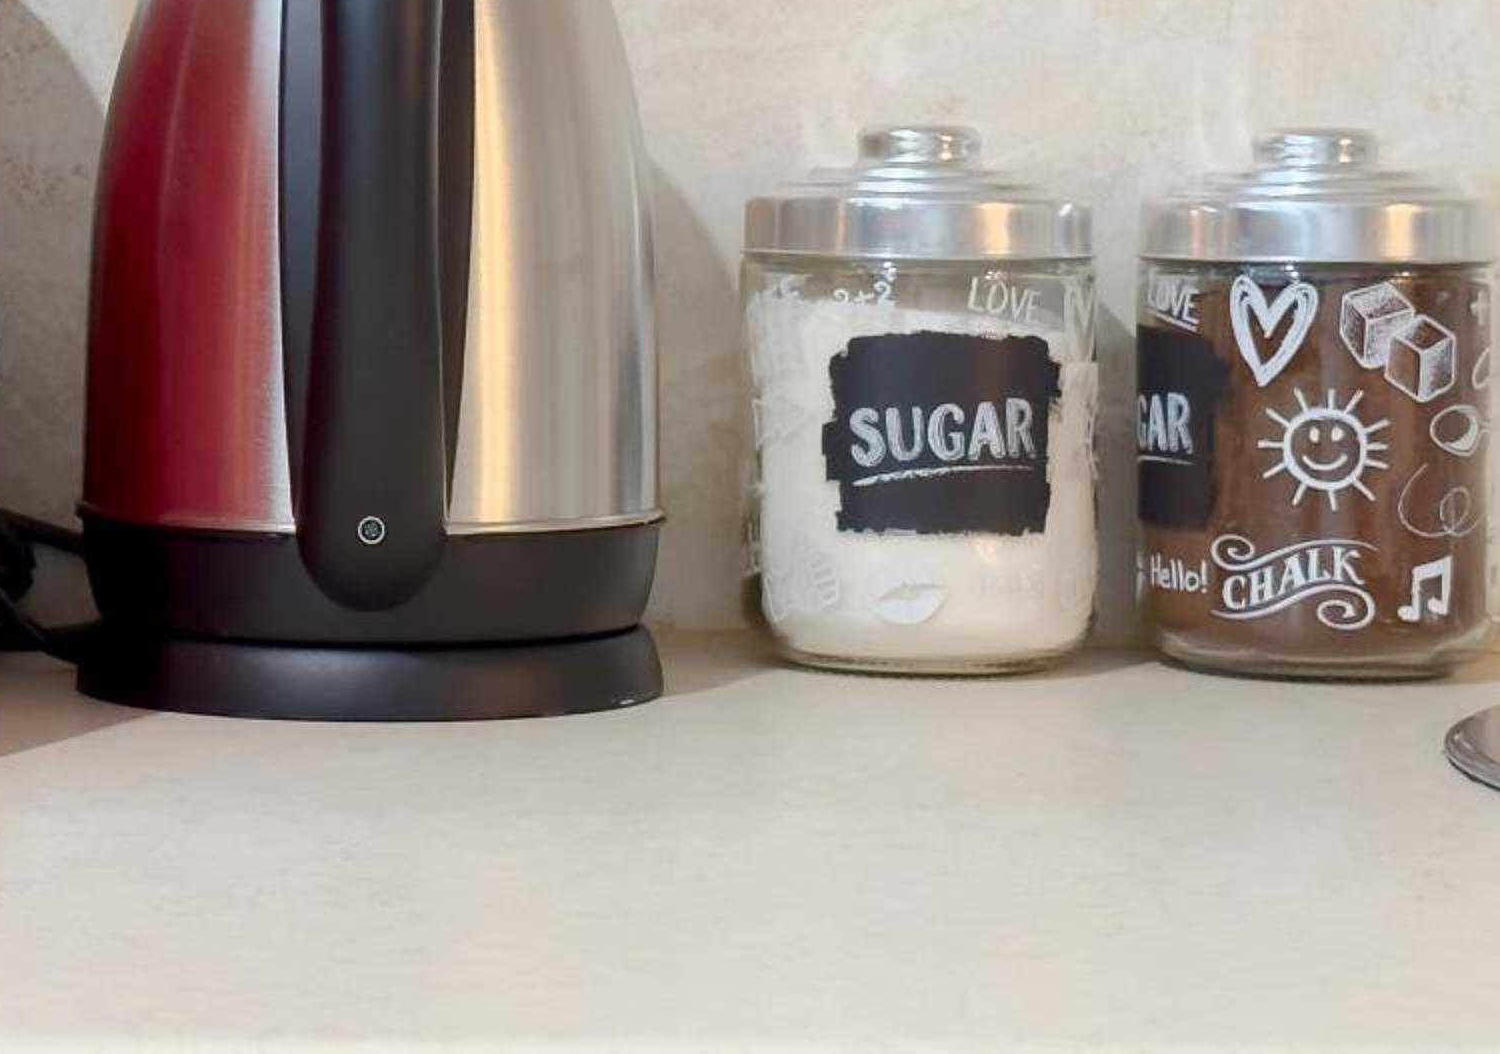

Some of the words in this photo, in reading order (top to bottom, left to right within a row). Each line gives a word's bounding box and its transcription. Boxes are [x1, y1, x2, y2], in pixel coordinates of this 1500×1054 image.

[967, 276, 1041, 323] LOVE
[1147, 274, 1200, 325] LOVE
[849, 397, 1037, 467] SUGAR
[1150, 552, 1208, 594] Hello!
[1222, 546, 1366, 610] CHALK
